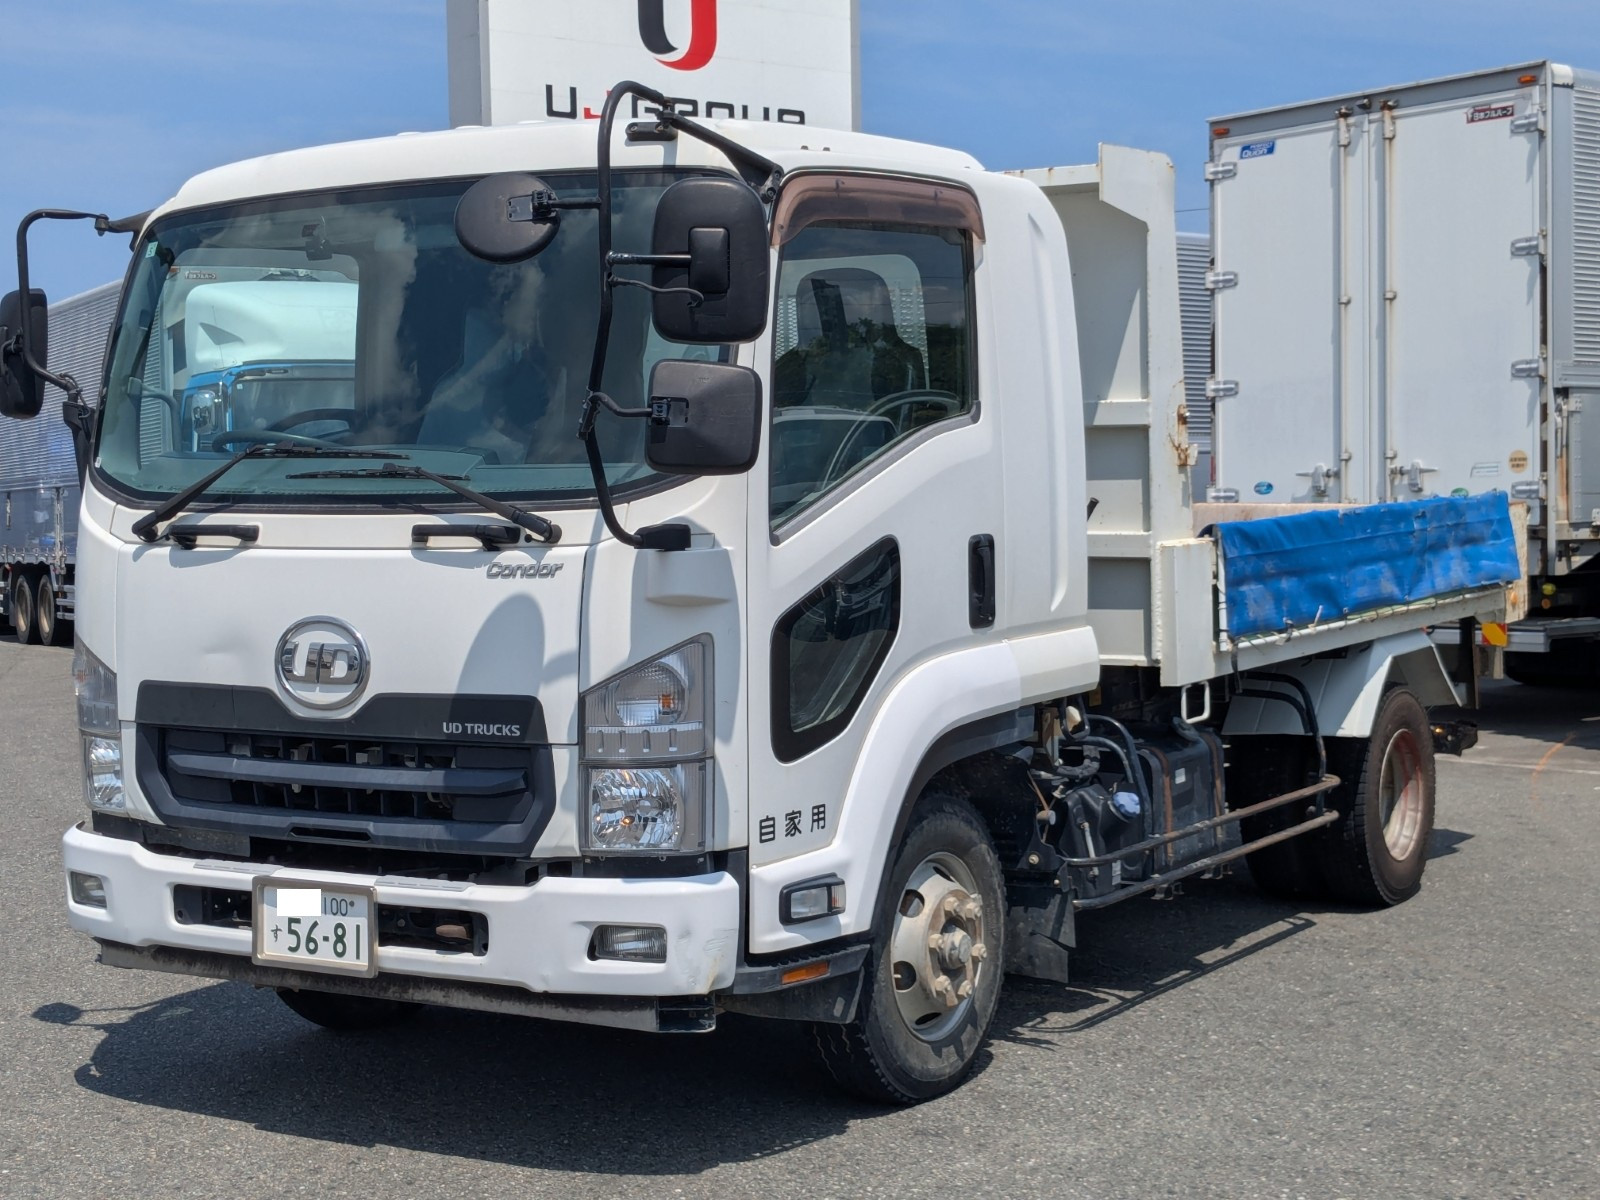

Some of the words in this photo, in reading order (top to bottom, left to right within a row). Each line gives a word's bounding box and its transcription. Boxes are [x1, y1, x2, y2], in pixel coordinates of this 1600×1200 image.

[486, 561, 564, 579] Condor
[281, 641, 361, 685] UD
[442, 721, 463, 734] UD
[464, 723, 521, 737] TRUCKS
[759, 803, 826, 844] 自家用
[324, 897, 348, 917] 100
[287, 917, 361, 960] 56-81
